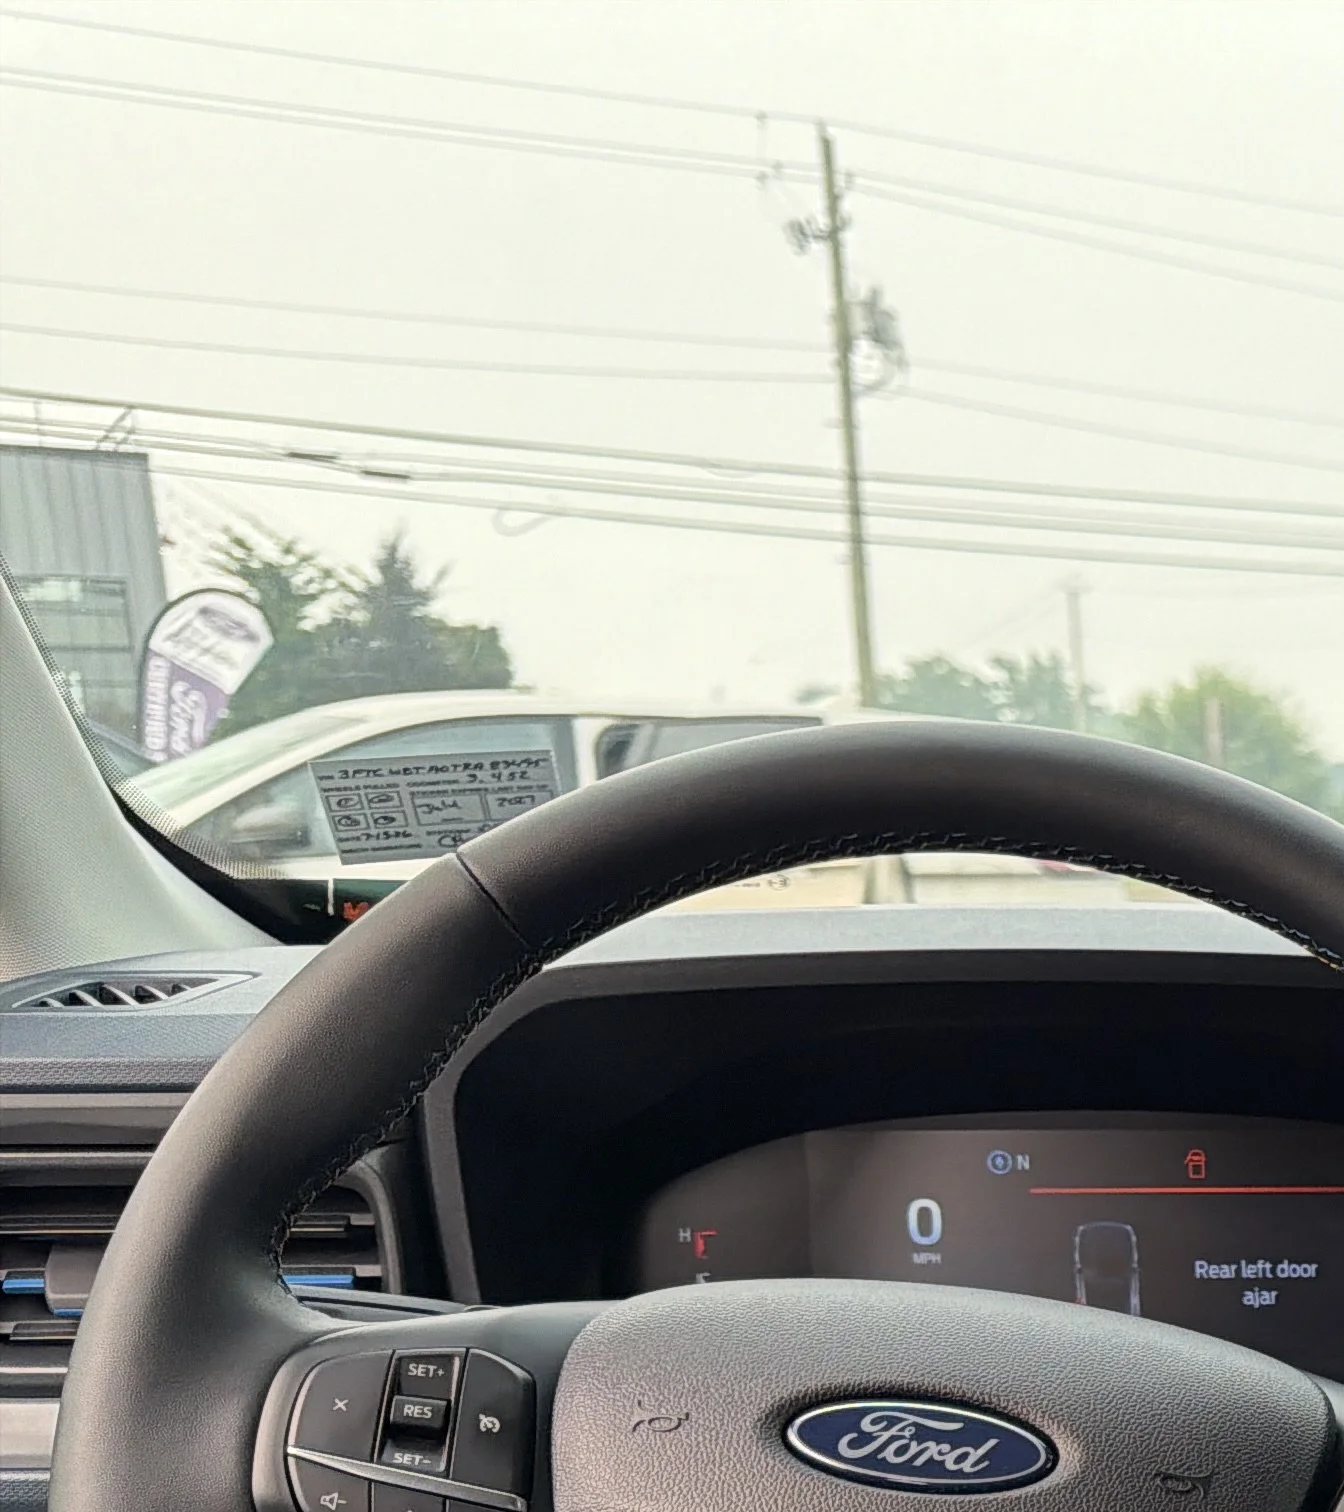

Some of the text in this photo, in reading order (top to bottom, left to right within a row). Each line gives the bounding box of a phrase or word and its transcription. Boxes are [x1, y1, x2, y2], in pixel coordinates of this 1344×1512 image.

[1016, 1155, 1030, 1171] N
[906, 1198, 943, 1246] 0
[678, 1228, 692, 1243] H
[912, 1252, 942, 1265] MPH
[1193, 1259, 1318, 1279] Rear left door
[1242, 1286, 1278, 1308] ajar
[407, 1363, 445, 1378] SET+
[403, 1404, 433, 1419] RES
[837, 1411, 1000, 1473] Ford
